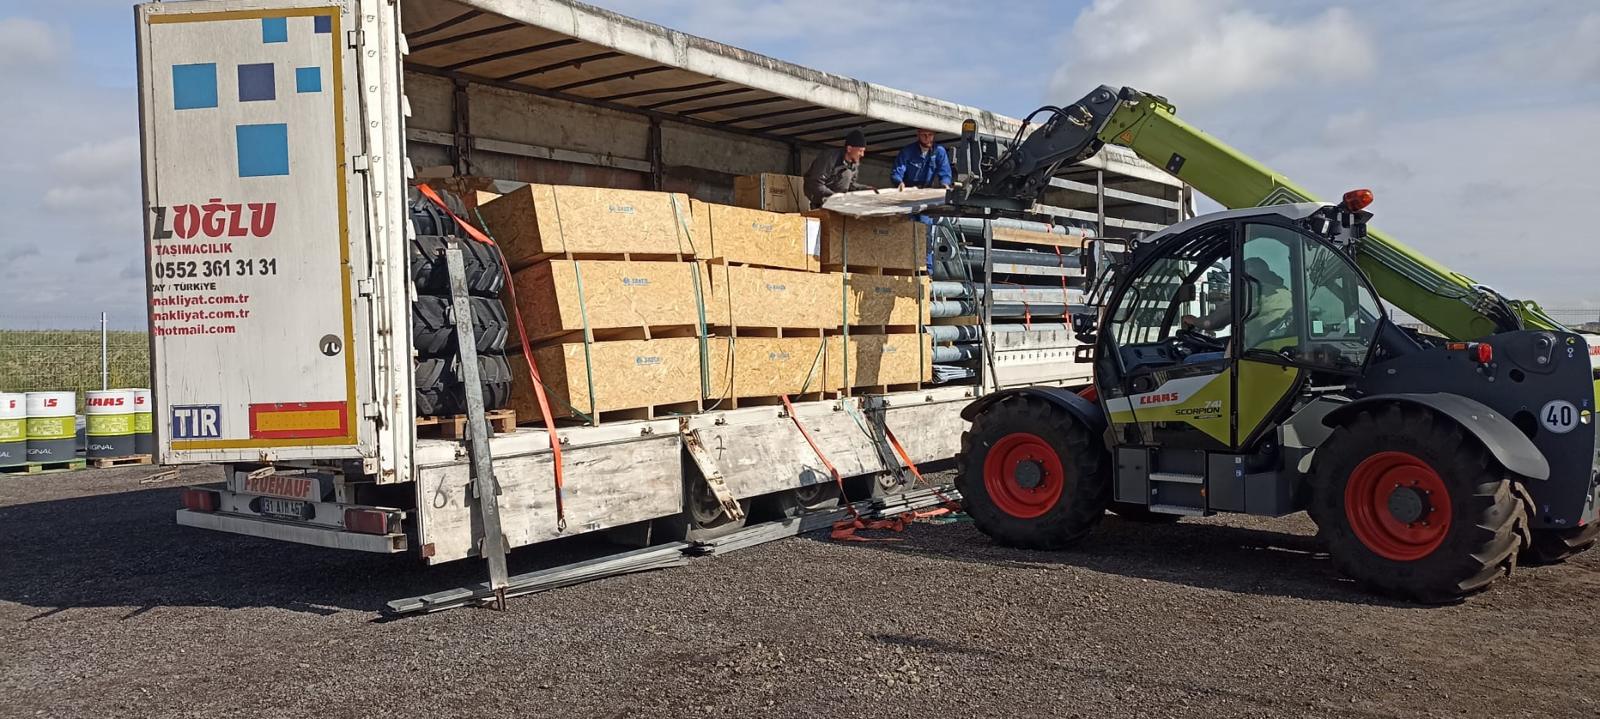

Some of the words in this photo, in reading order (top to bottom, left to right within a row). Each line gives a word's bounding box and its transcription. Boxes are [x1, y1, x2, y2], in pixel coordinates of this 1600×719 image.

[155, 261, 198, 279] 0552
[203, 260, 231, 278] 361
[236, 259, 254, 276] 31
[259, 257, 278, 275] 31
[1140, 392, 1178, 405] CLAAS
[1175, 407, 1221, 416] SCORPION
[1546, 405, 1572, 427] 40
[174, 408, 219, 438] TIR
[244, 476, 312, 498] FRUEHAUF
[432, 473, 448, 509] 6
